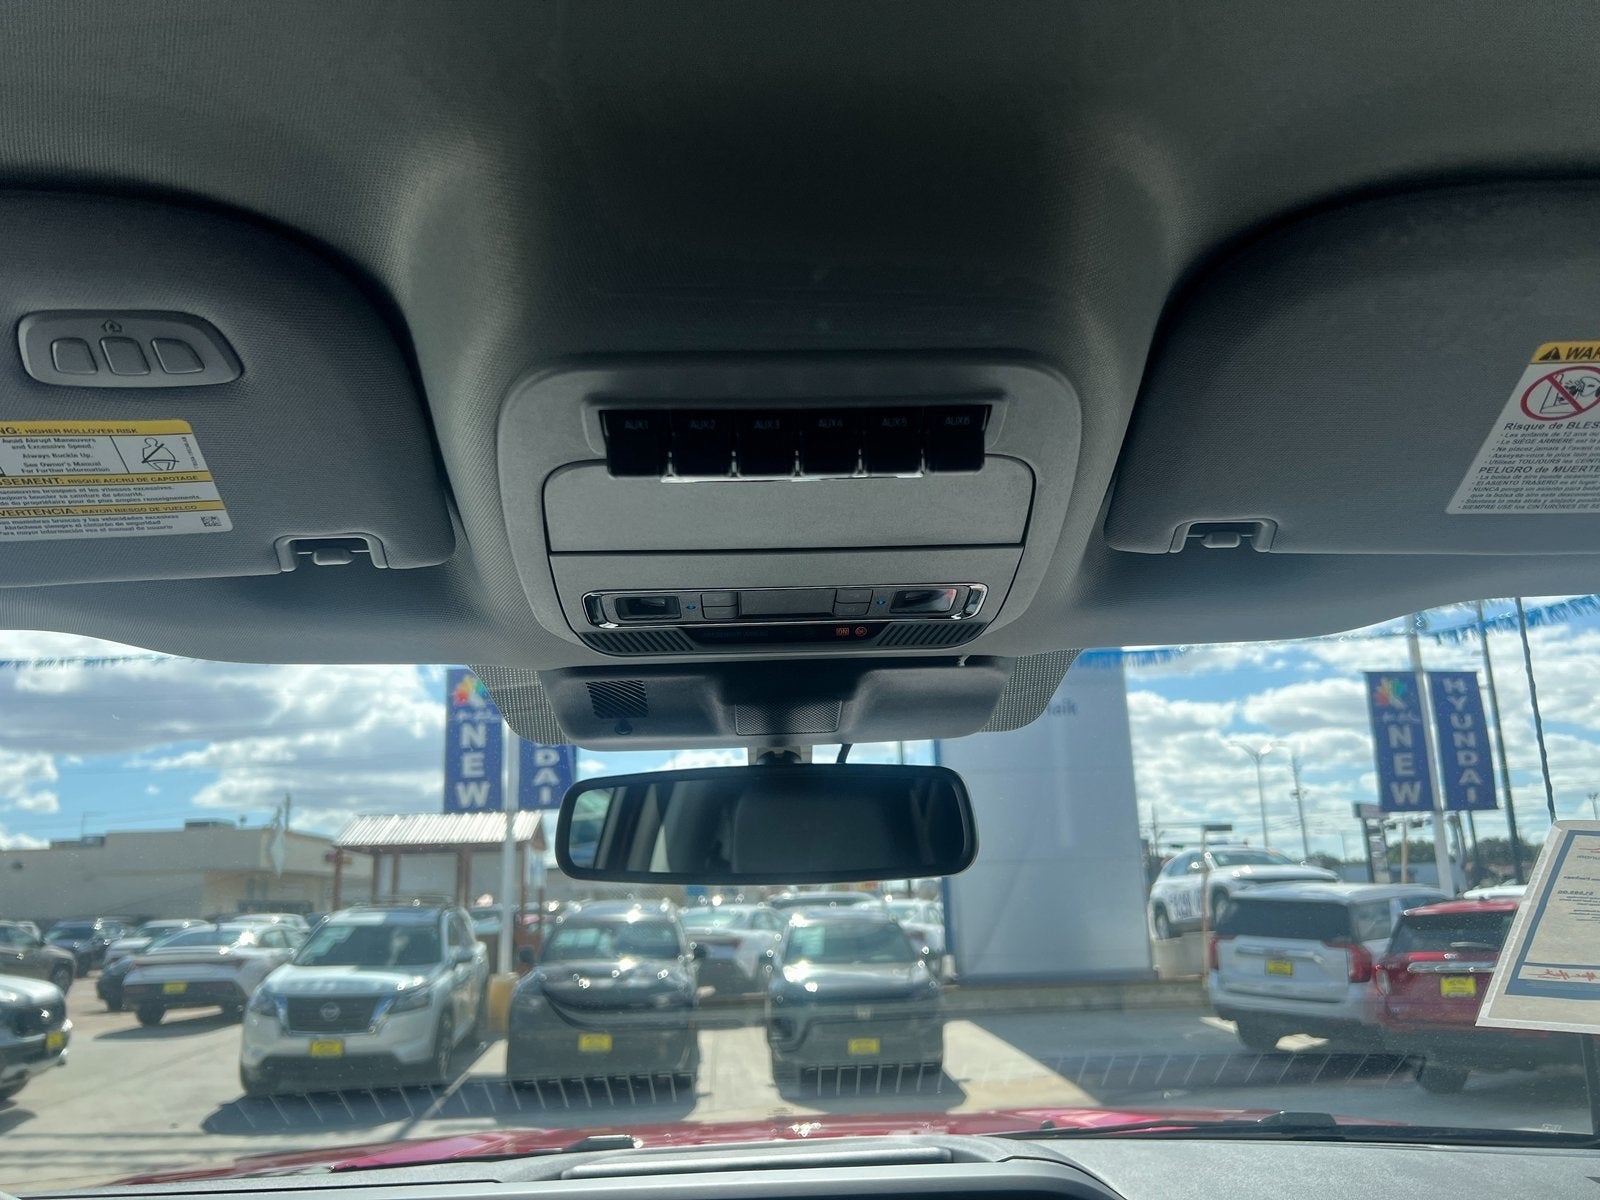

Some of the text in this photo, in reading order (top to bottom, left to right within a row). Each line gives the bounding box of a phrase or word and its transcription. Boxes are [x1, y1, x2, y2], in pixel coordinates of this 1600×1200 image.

[689, 419, 717, 430] AUX2
[753, 418, 781, 429] AUX3
[817, 418, 843, 428] AUX4
[881, 417, 908, 427] AUX5
[945, 416, 971, 426] AUX6
[1504, 422, 1545, 432] Risque
[1549, 422, 1563, 430] de
[1478, 466, 1533, 474] PELIGRO
[0, 477, 65, 486] SEMENT:
[1442, 677, 1484, 804] HYUNDAI
[456, 721, 491, 809] NEW
[1386, 723, 1422, 807] NEW
